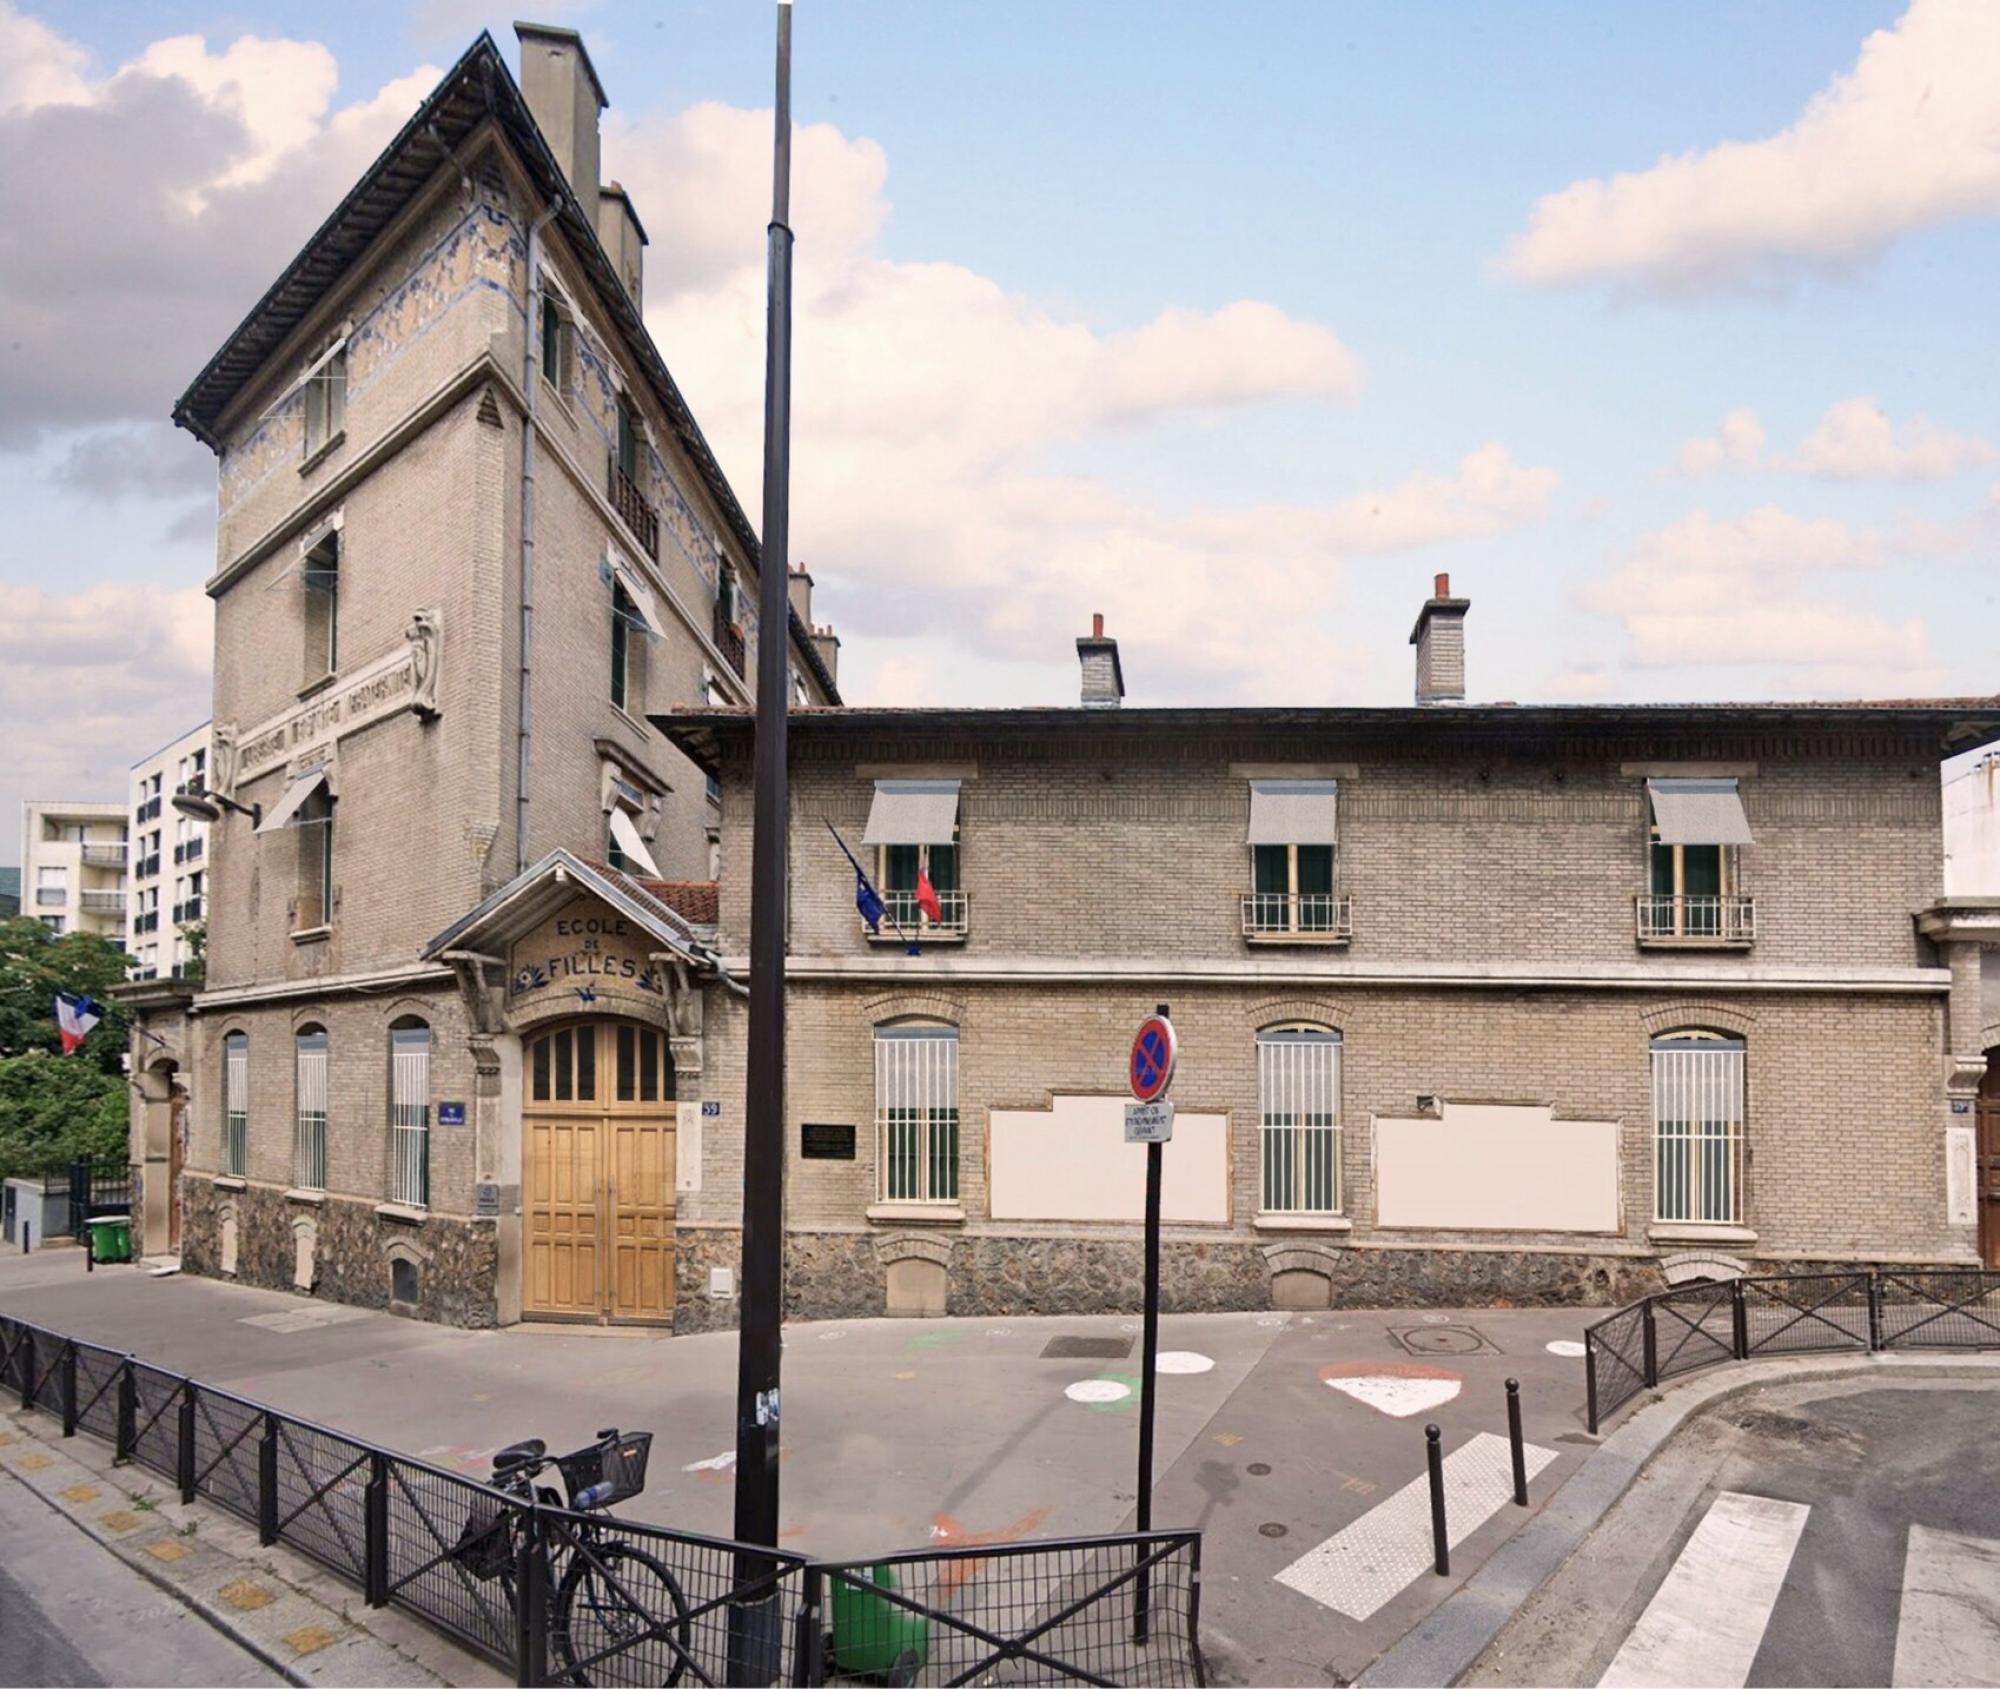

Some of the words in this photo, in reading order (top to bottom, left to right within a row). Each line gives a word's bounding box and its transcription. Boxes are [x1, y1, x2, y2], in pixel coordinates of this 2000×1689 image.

[557, 919, 628, 936] ECOLE
[584, 939, 599, 949] DE
[548, 955, 636, 978] FILLES
[703, 1103, 718, 1116] 59
